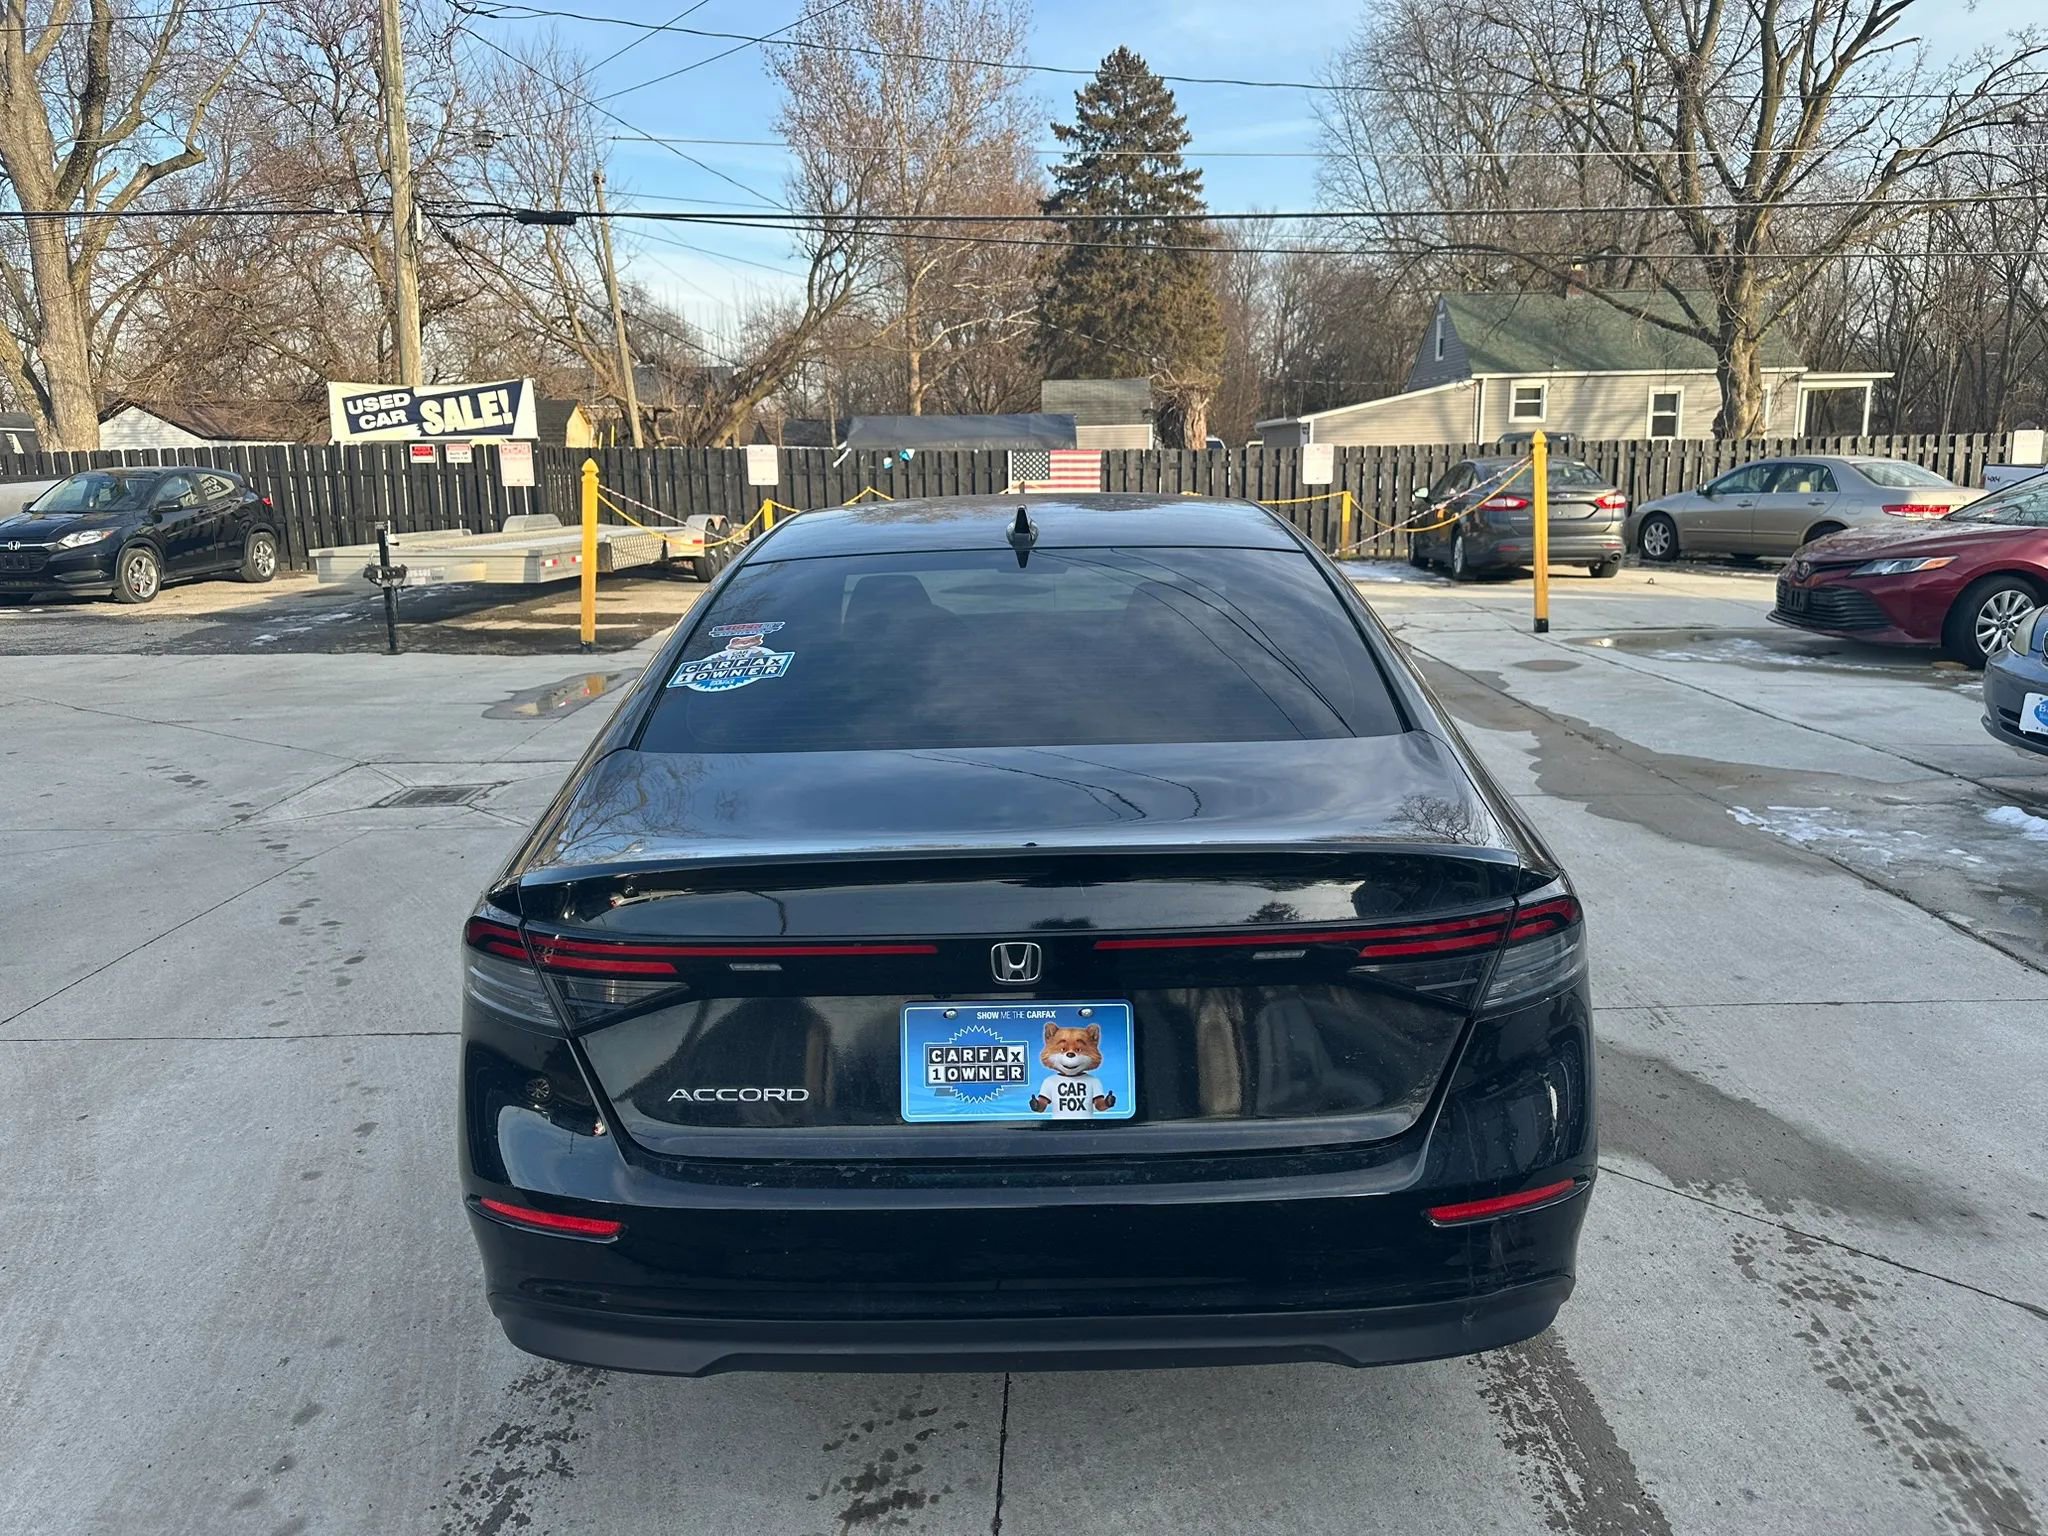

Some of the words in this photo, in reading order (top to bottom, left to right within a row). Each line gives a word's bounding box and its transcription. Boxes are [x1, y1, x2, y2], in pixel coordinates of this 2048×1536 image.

[346, 393, 411, 415] USED
[419, 389, 514, 435] SALE!
[358, 409, 408, 430] CAR
[684, 657, 783, 673] CARFAX
[976, 1011, 999, 1020] SHOW
[1000, 1011, 1011, 1020] ME
[1012, 1010, 1025, 1019] THE
[1026, 1010, 1056, 1019] CARFAX
[931, 1047, 1022, 1063] CARFAX
[667, 1088, 810, 1102] ACCORD
[1057, 1082, 1087, 1097] CAR
[1058, 1097, 1087, 1111] FOX
